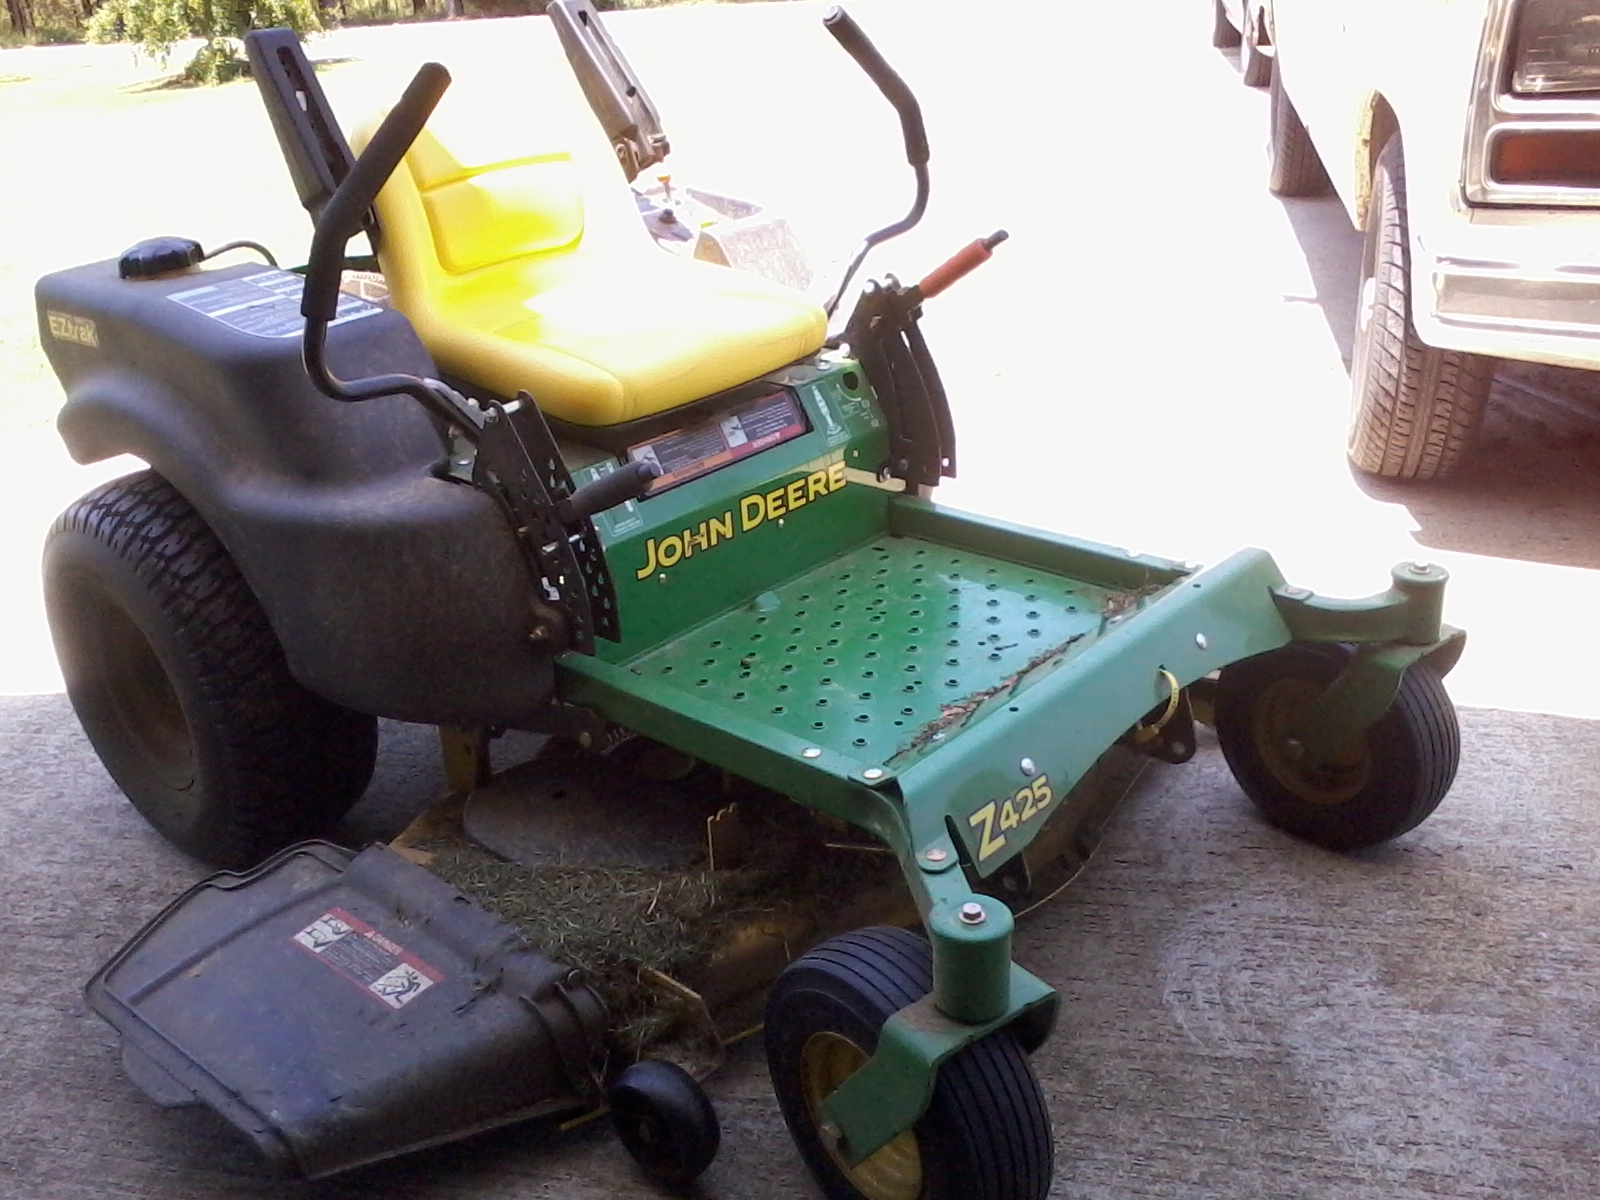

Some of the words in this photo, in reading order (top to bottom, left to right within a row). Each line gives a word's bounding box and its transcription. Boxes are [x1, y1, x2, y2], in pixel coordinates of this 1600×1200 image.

[636, 510, 734, 580] JOHN
[739, 461, 848, 532] DEERE
[968, 774, 1052, 862] Z425
